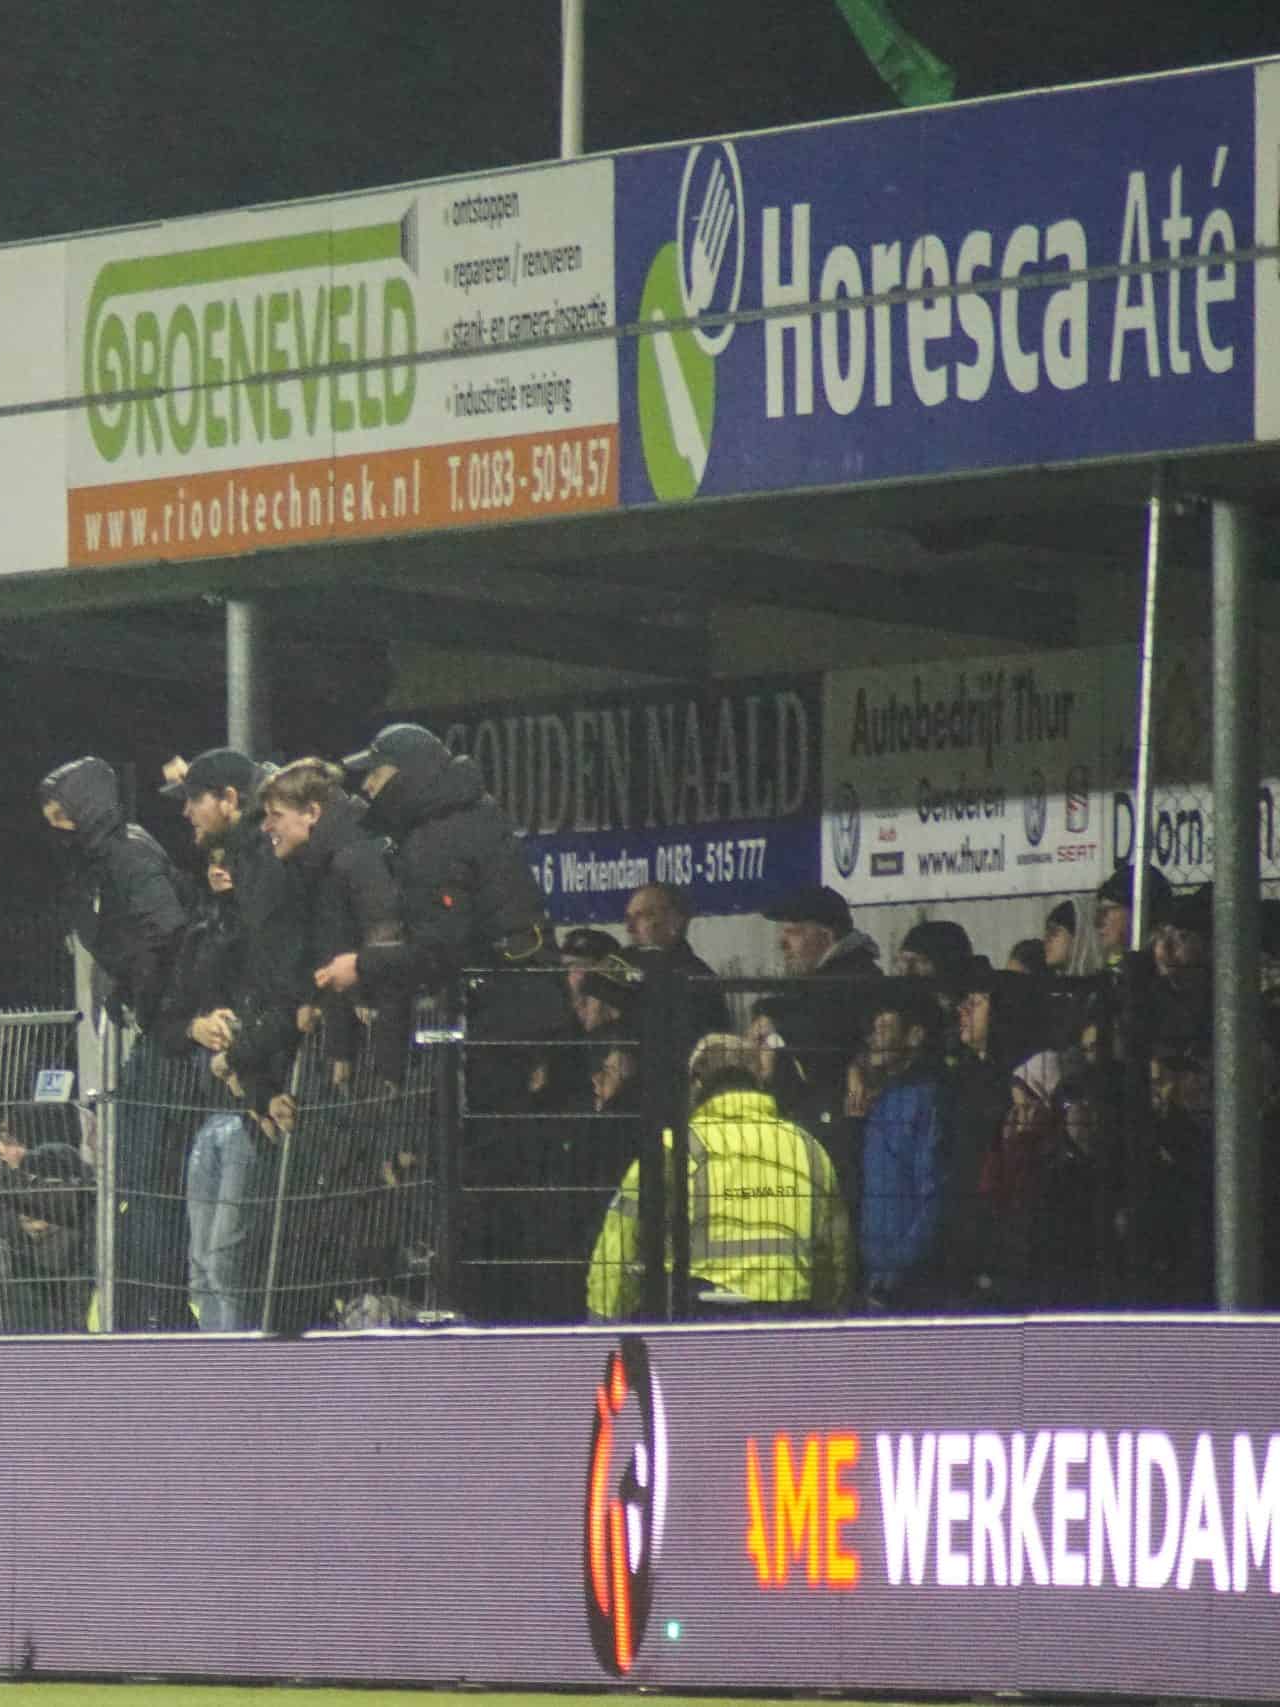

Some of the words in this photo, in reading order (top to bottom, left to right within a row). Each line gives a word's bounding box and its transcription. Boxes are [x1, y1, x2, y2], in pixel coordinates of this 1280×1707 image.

[451, 192, 520, 229] ontstoppen
[762, 203, 1089, 419] Horesca
[1109, 145, 1236, 384] Até
[84, 276, 417, 463] GROENEVELD
[520, 372, 572, 415] reiniging
[85, 458, 420, 552] www.riooltechniek.nl
[1014, 666, 1077, 742] Thur
[446, 709, 633, 840] OUDEN
[645, 692, 811, 829] NAALD
[559, 851, 649, 893] Werkendam
[917, 833, 1006, 877] www.thur.nl
[723, 1185, 800, 1200] STEWARD
[875, 1430, 1280, 1593] WERKENDAM
